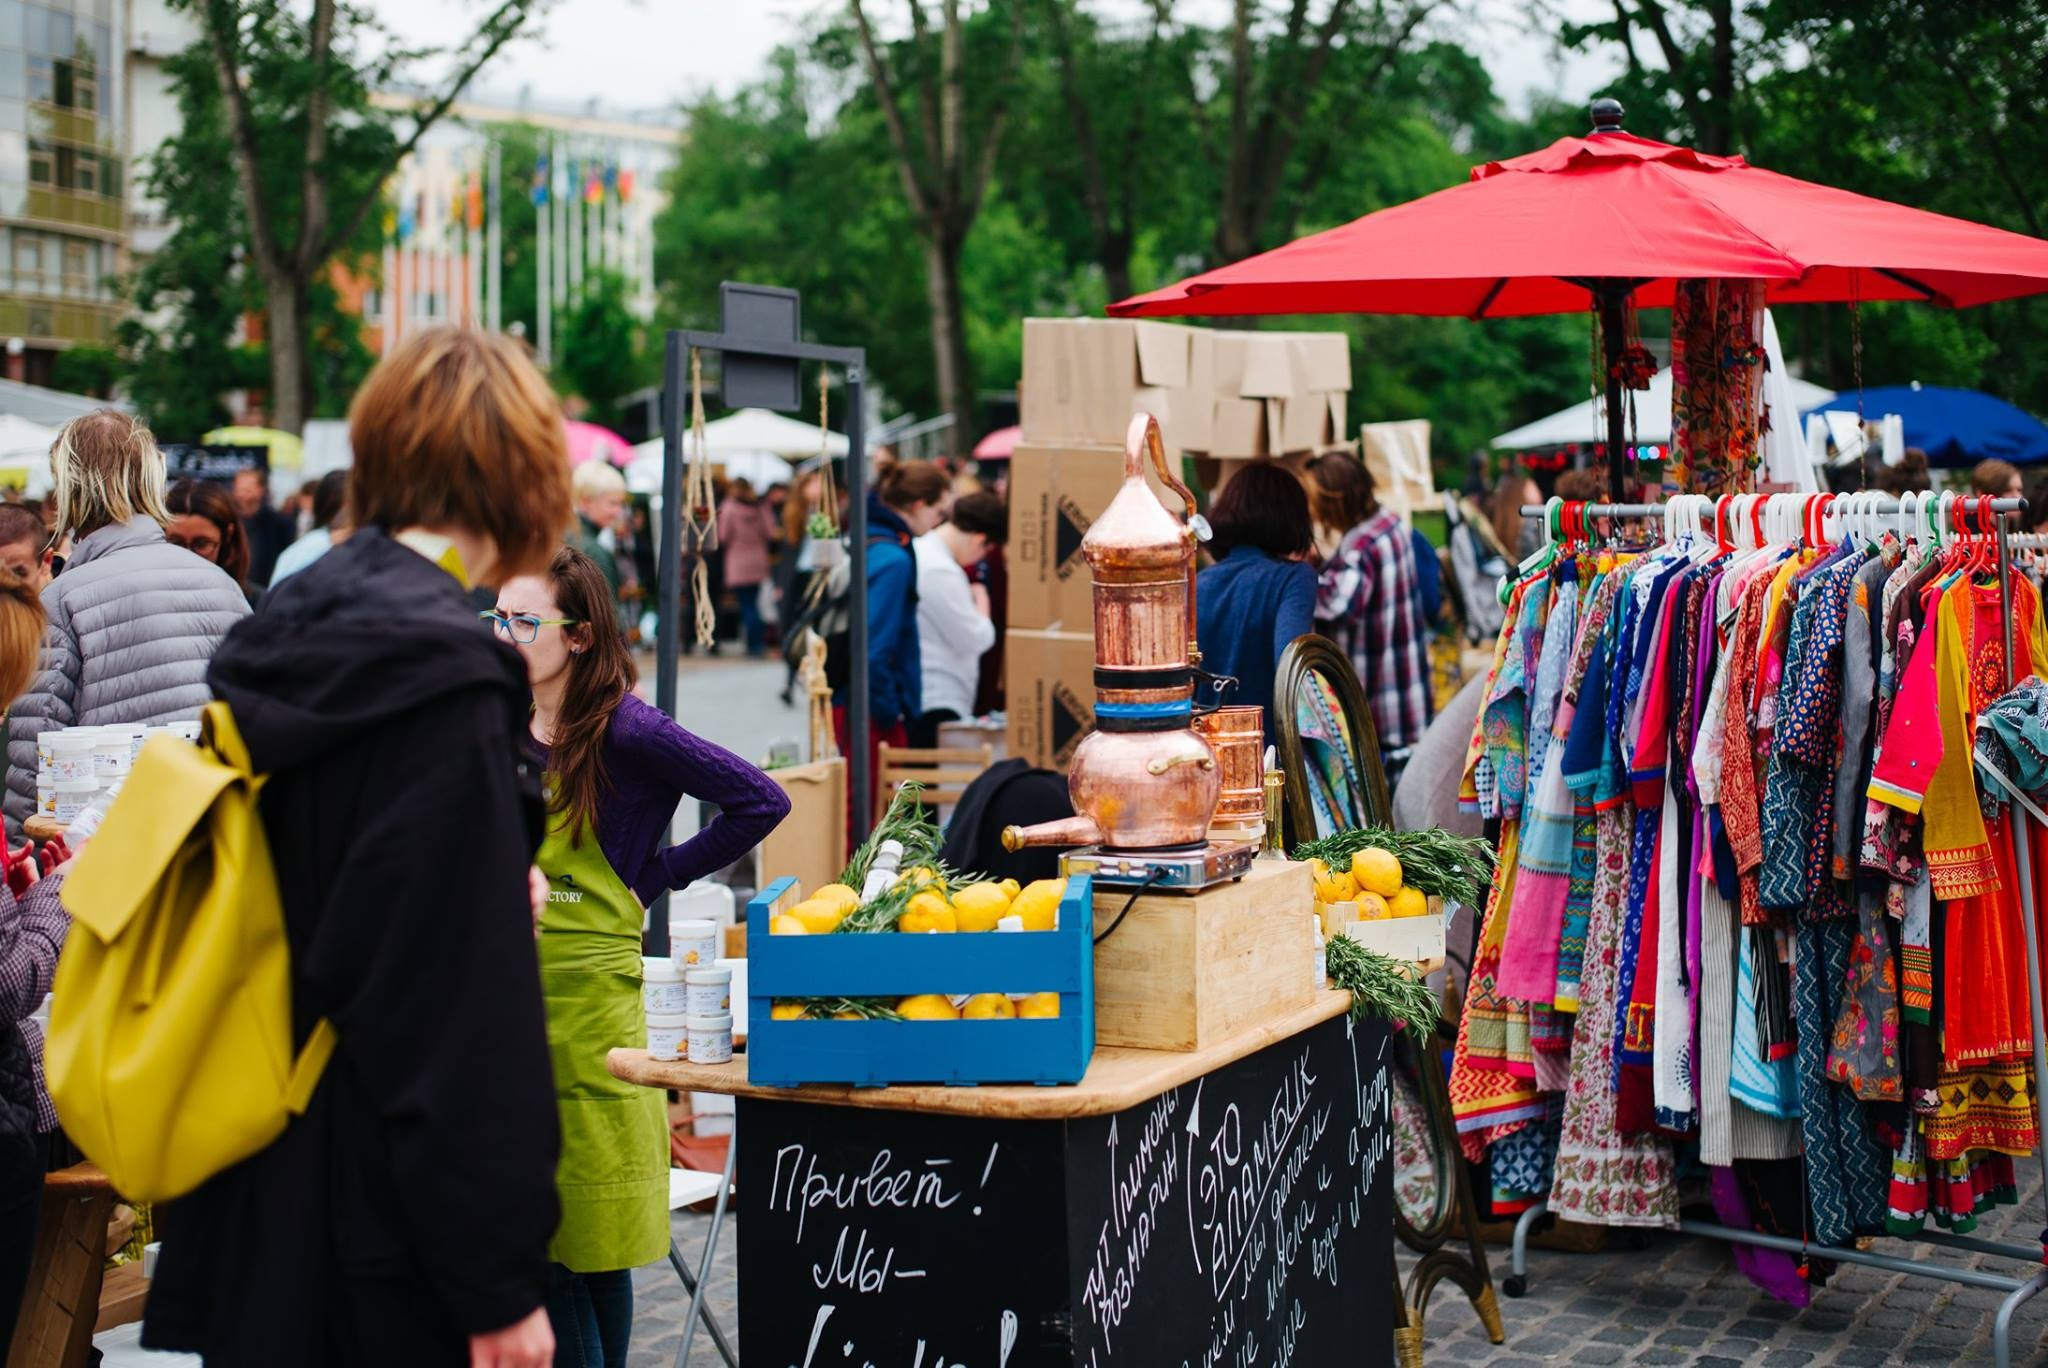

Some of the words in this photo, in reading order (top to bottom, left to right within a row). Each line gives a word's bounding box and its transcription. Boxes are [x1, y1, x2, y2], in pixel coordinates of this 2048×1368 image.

[1200, 1102, 1241, 1230] ЭТО
[1083, 1219, 1109, 1324] ТУТ
[1101, 1131, 1179, 1355] РОЗМАРИН
